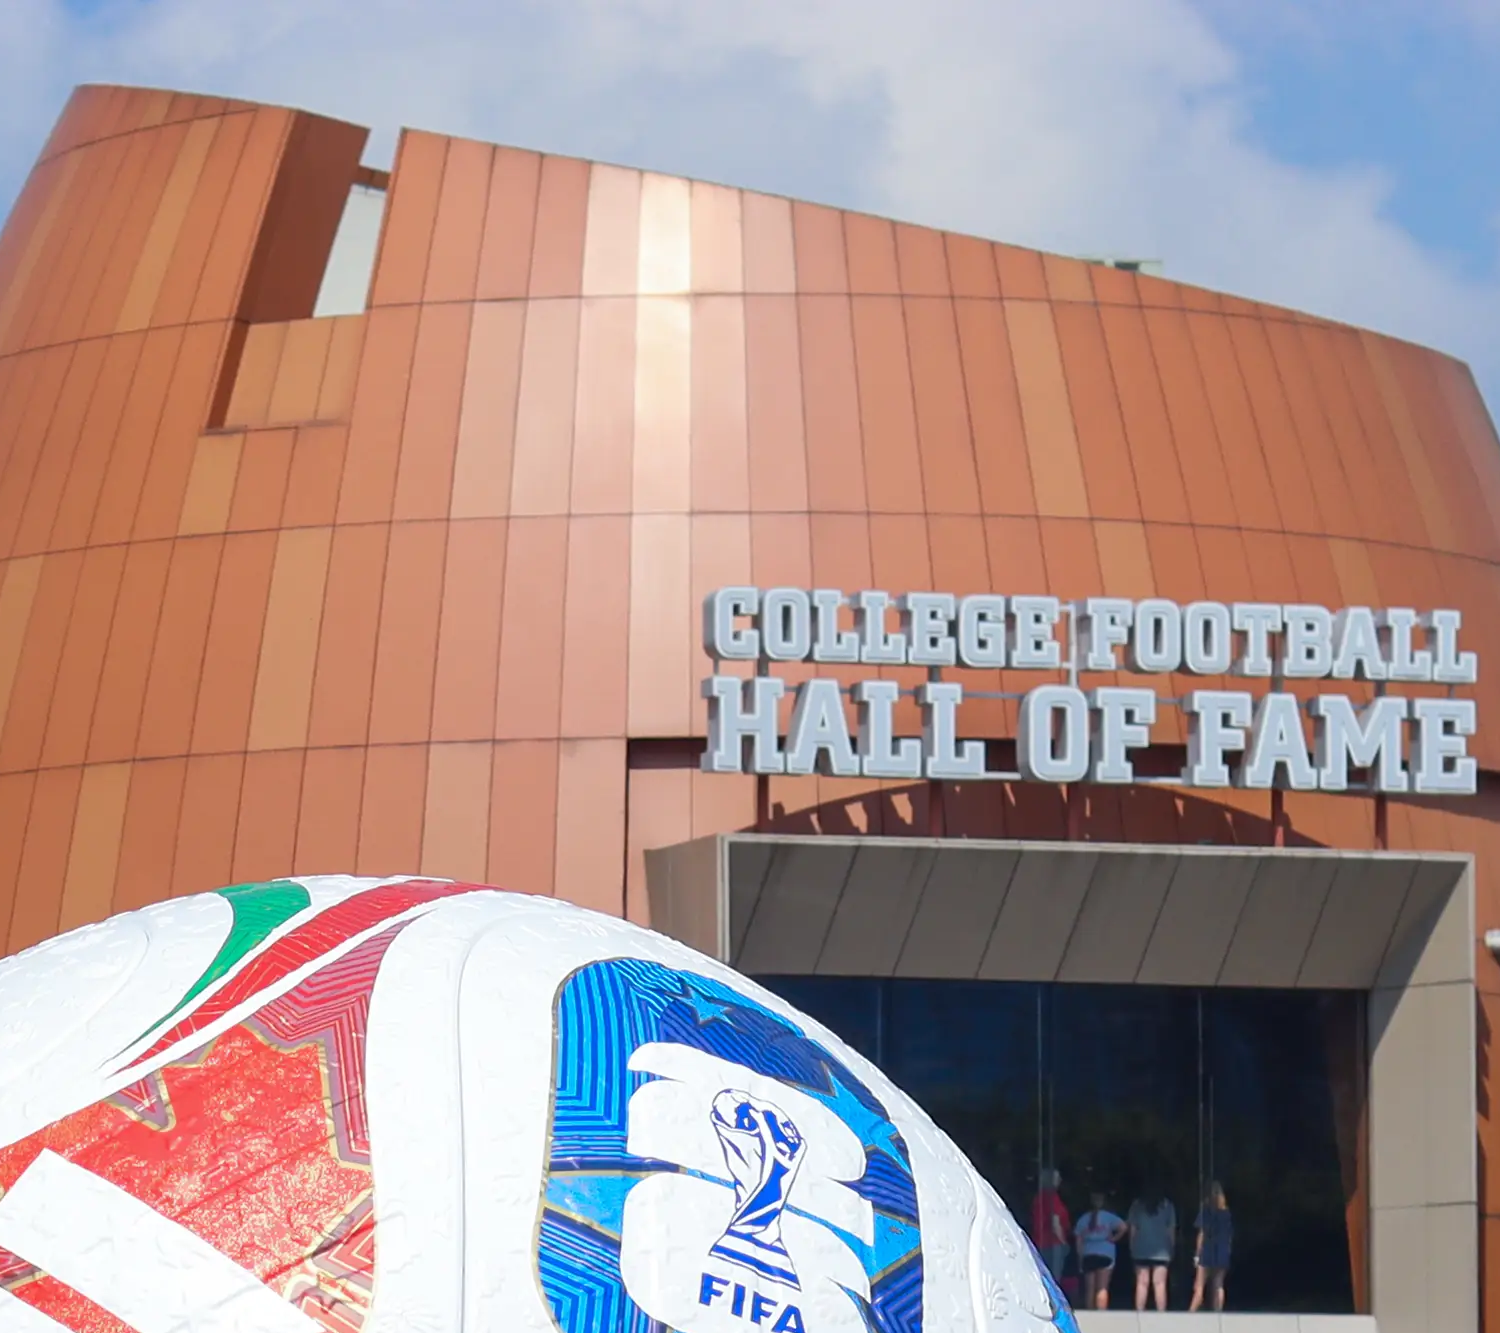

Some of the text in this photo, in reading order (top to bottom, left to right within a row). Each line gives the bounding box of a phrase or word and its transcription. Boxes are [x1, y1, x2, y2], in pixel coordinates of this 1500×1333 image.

[704, 586, 1477, 684] COLLEGE FOOTBALL
[701, 676, 1477, 796] HALL OF FAME
